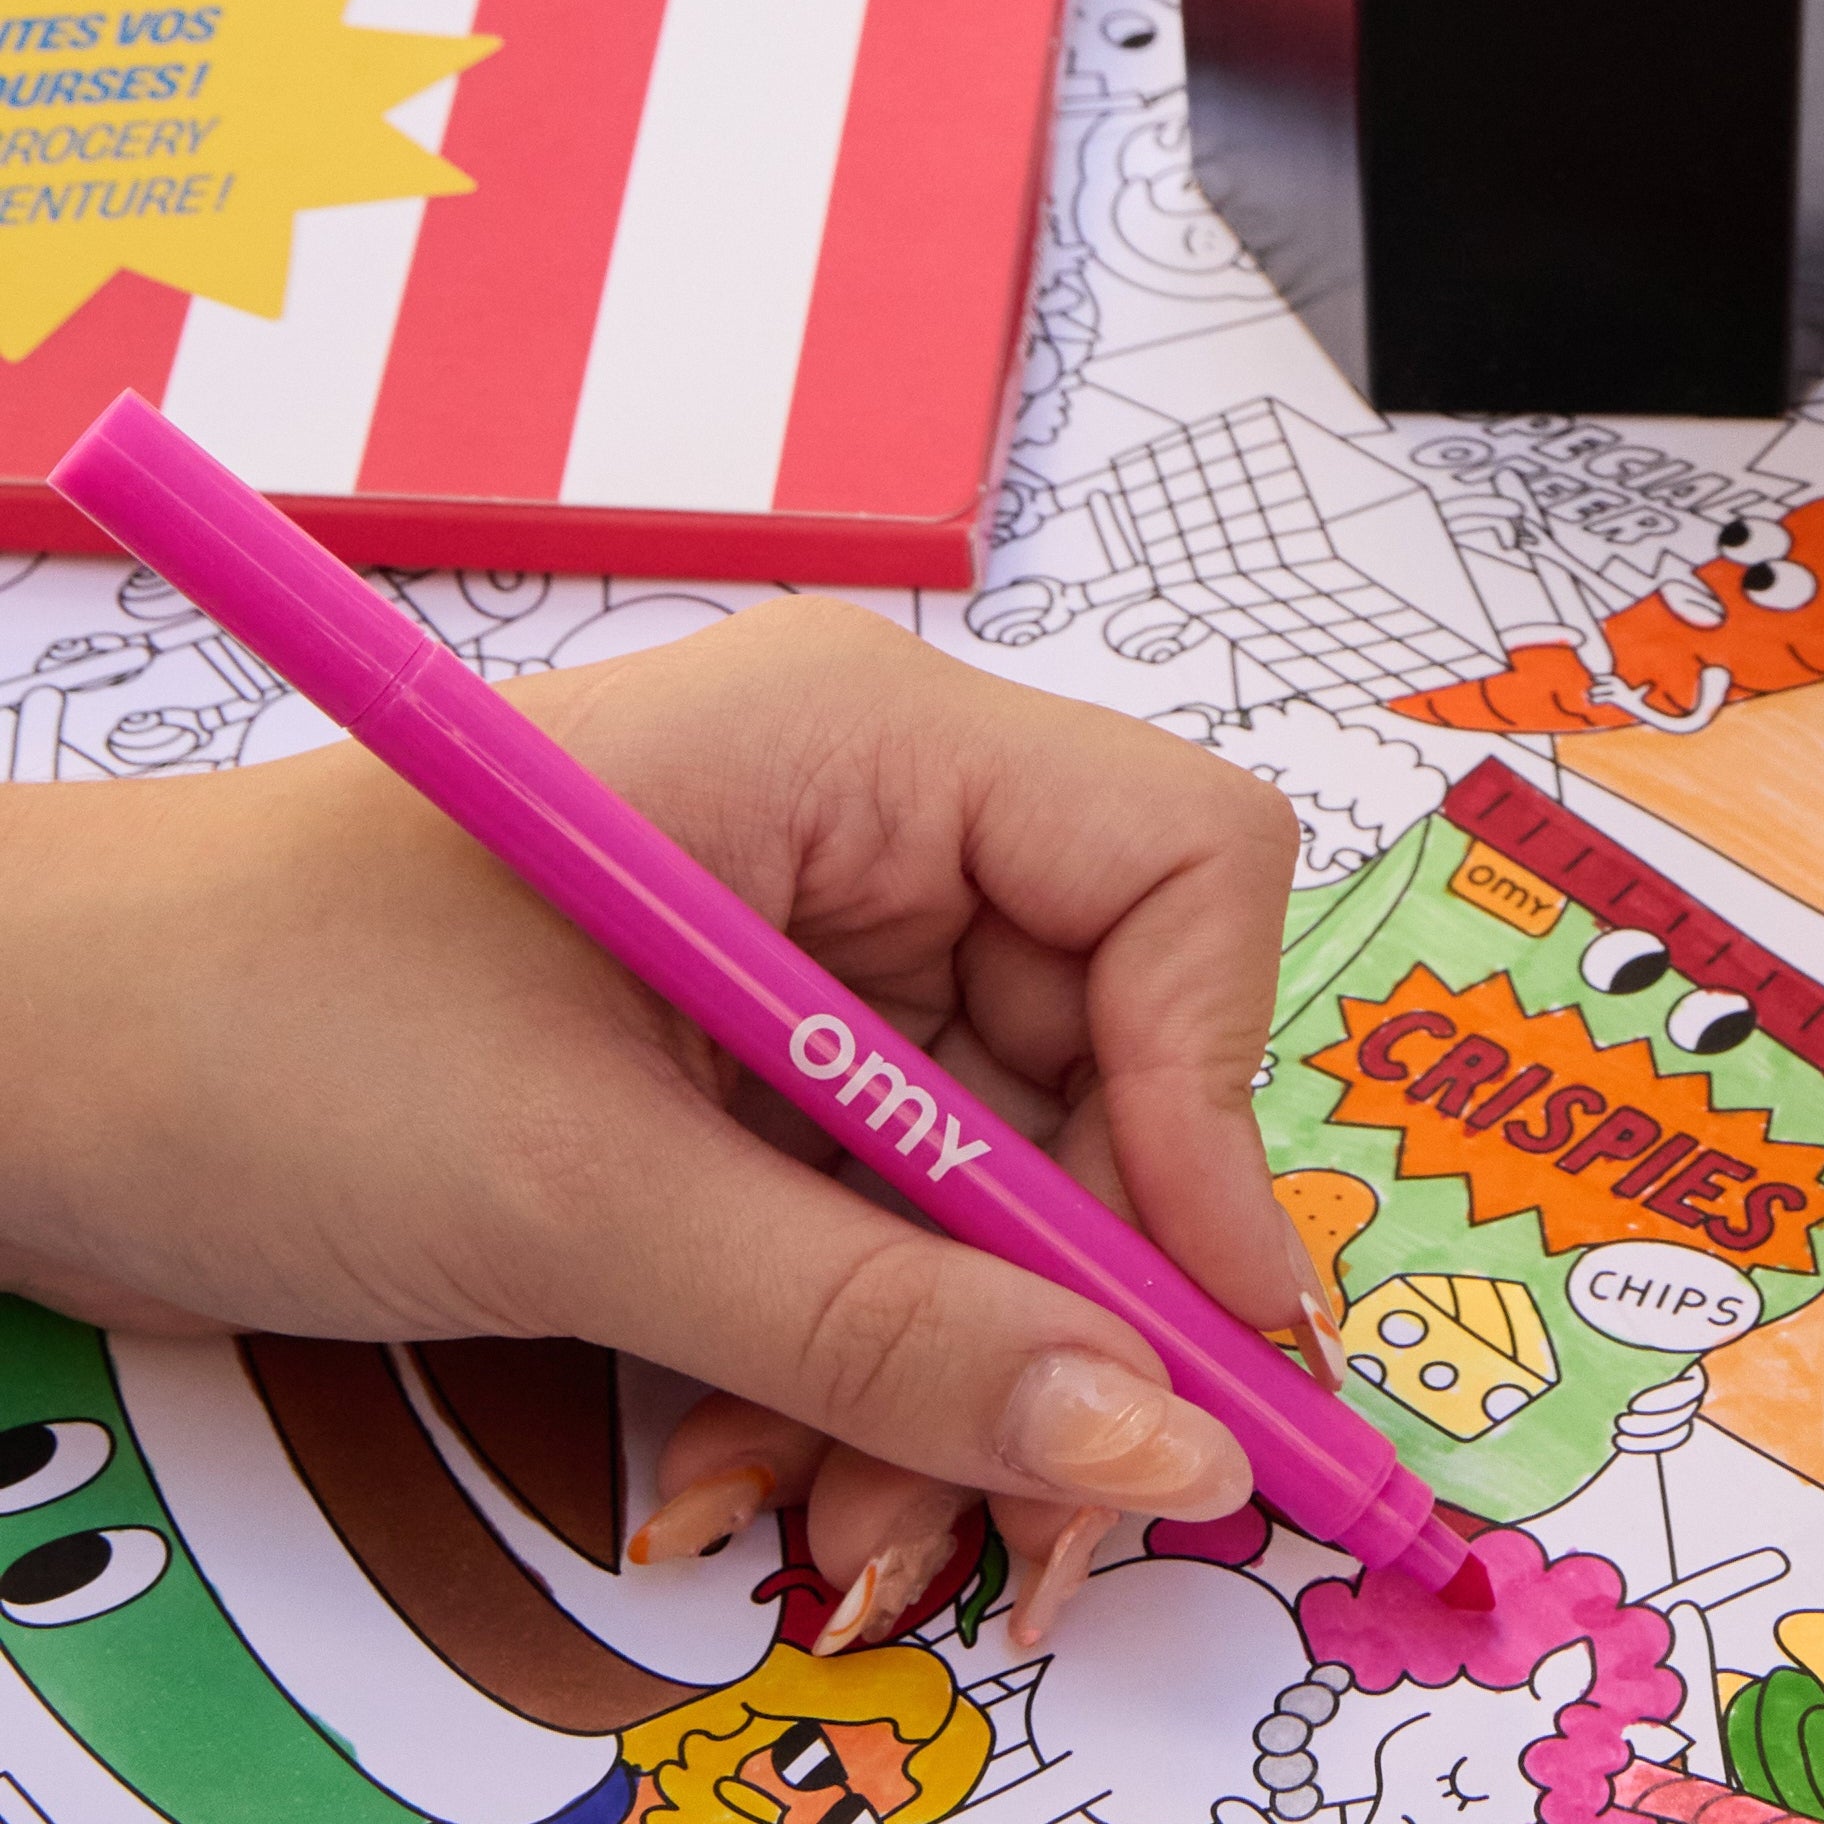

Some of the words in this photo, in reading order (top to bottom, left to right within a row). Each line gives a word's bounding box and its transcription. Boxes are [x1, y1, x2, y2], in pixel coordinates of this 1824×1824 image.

[117, 5, 222, 47] VOS
[0, 62, 211, 109] URSES!
[0, 117, 221, 168] ROCERY
[1455, 413, 1768, 528] PECIAL
[789, 1013, 992, 1182] omy
[1357, 1010, 1807, 1253] CRISPIES
[1589, 1270, 1744, 1328] CHIPS
